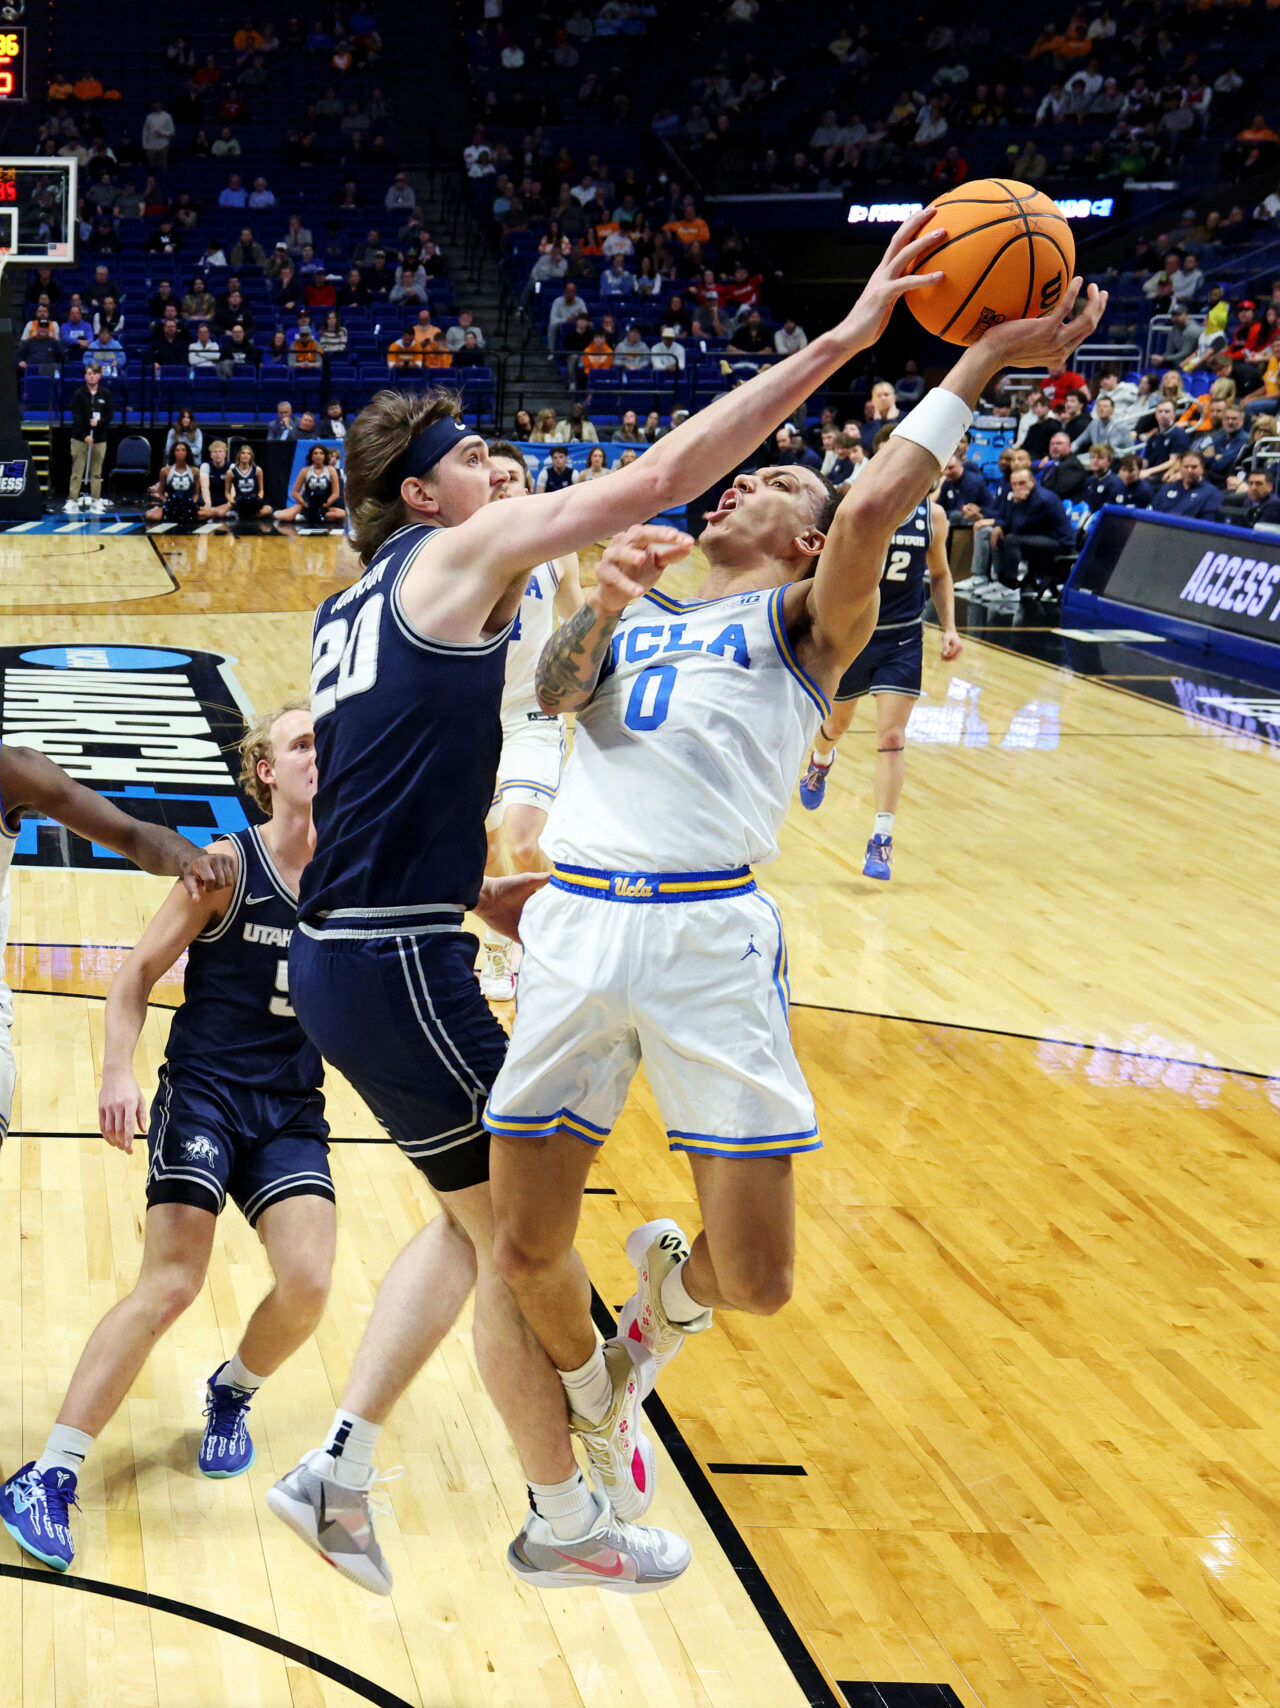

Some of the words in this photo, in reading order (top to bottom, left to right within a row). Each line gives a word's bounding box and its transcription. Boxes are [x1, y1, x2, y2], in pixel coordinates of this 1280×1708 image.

[1179, 550, 1280, 617] ACCESS
[310, 592, 385, 725] 20
[3, 667, 236, 785] MARCH
[623, 664, 678, 731] 0
[614, 877, 654, 897] Ucla
